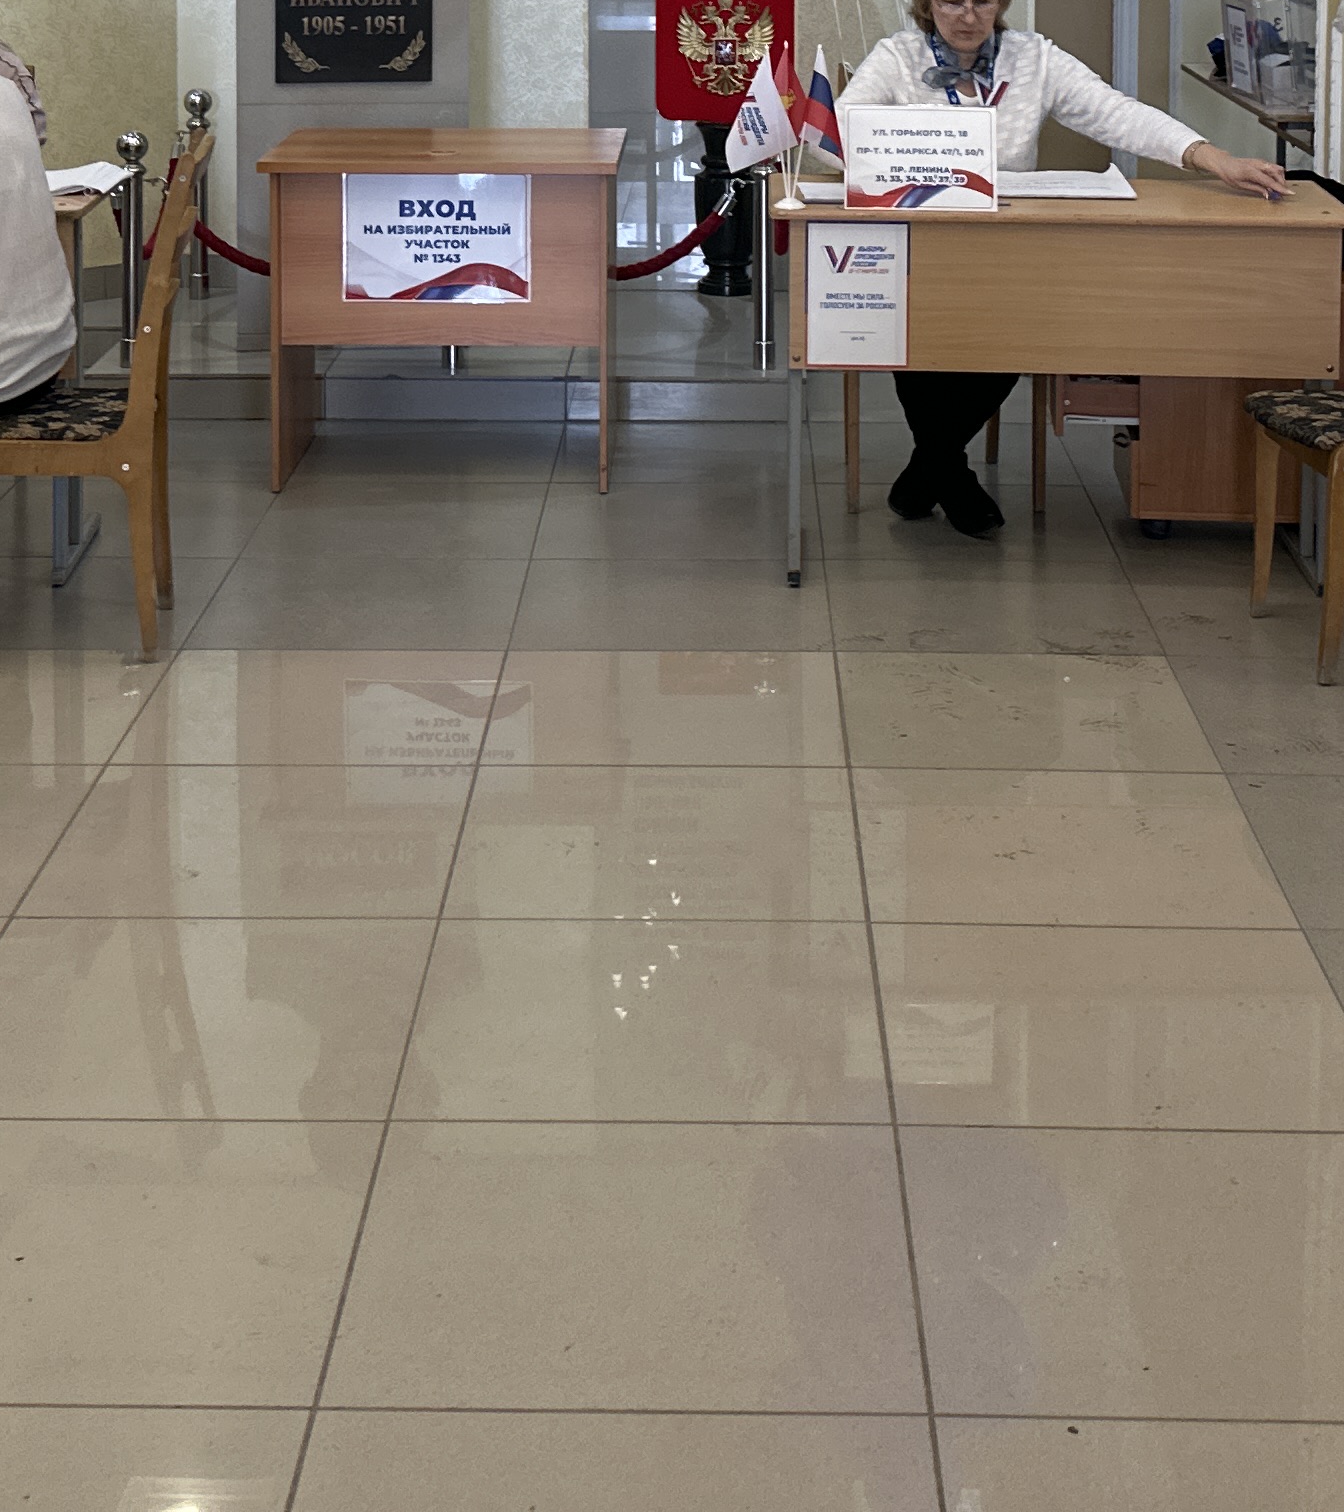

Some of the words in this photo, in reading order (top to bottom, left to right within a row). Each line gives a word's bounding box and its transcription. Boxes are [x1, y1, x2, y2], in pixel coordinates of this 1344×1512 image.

[302, 16, 346, 36] 1905
[364, 15, 407, 36] 1951
[890, 129, 942, 137] ГОРЬКОГО
[908, 166, 950, 174] ЛЕНИНА
[399, 199, 476, 221] ВХОД
[363, 225, 384, 235] НА
[387, 223, 511, 235] ИЗБИРАТЕЛЬНЫЙ
[405, 239, 470, 250] УЧАСТОК
[433, 254, 461, 263] 1343
